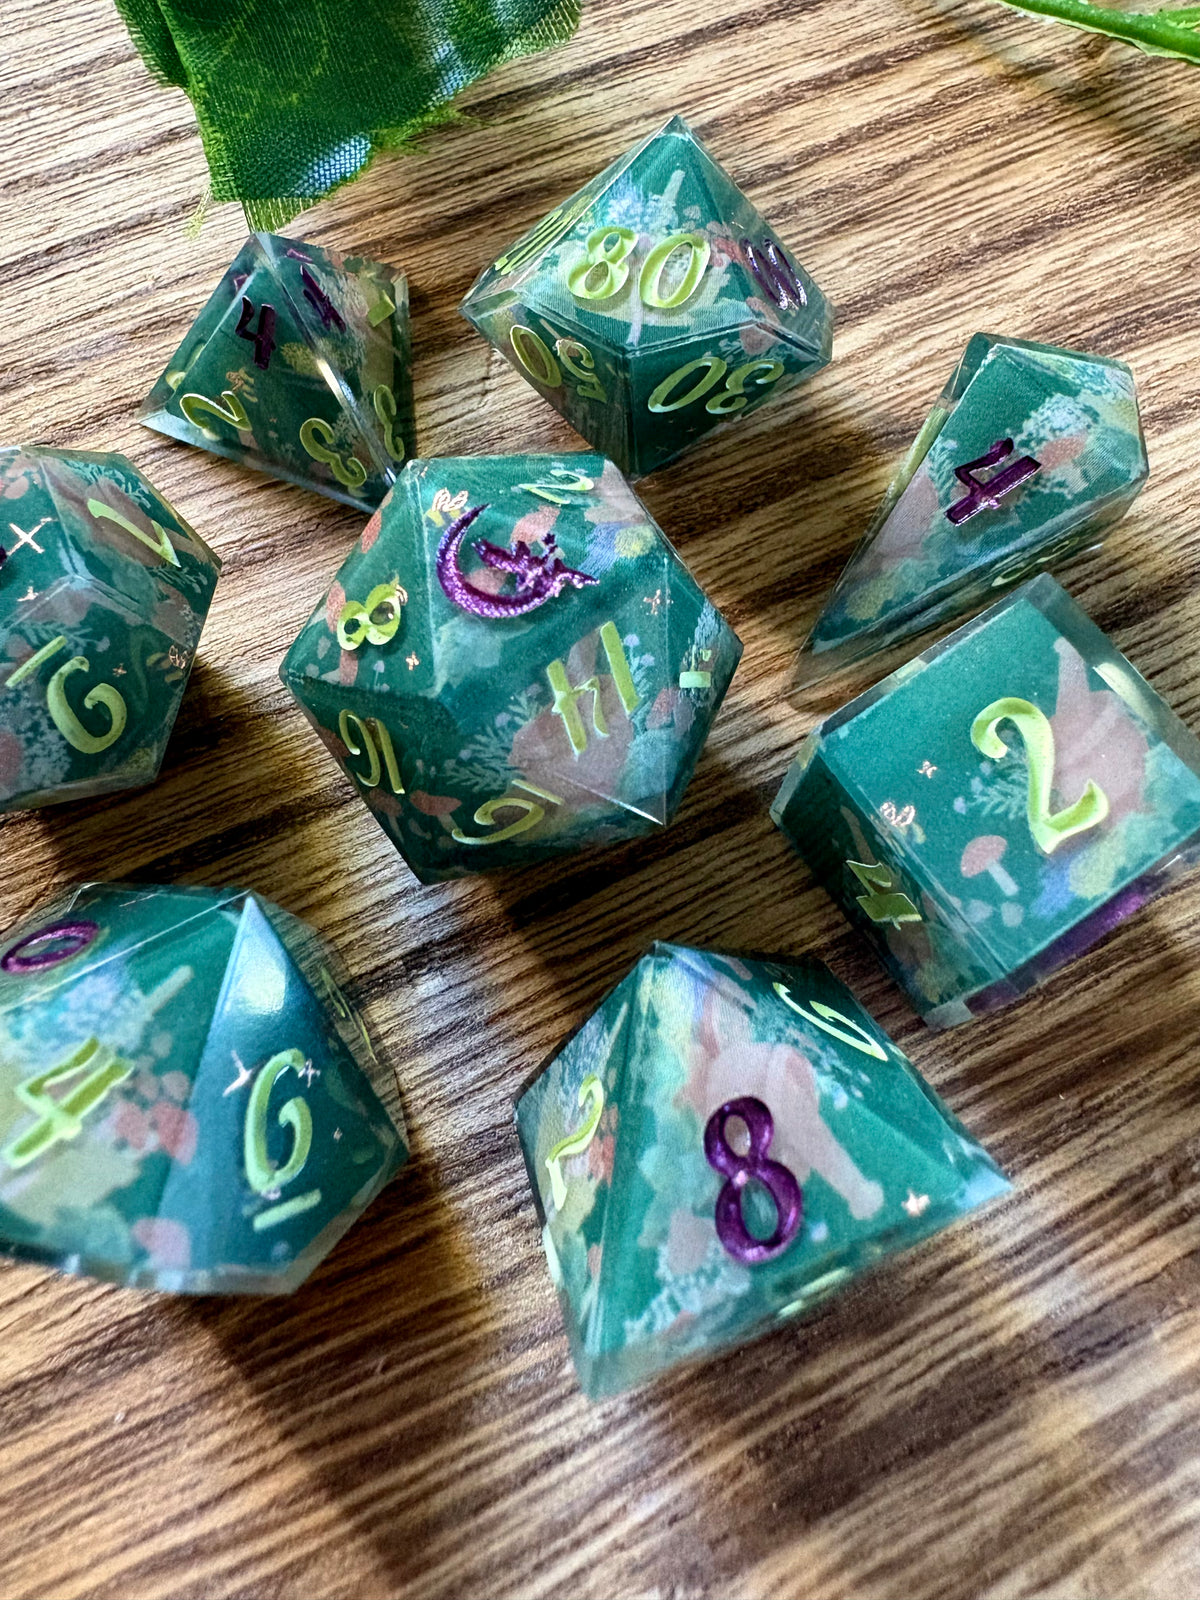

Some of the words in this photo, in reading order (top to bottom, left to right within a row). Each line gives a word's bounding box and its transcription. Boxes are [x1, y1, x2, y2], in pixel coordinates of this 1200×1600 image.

[567, 226, 711, 309] 80
[235, 295, 277, 370] 4
[299, 417, 367, 487] 3
[944, 437, 1043, 527] 4
[336, 581, 402, 652] 8
[970, 696, 1109, 855] 2
[1, 920, 100, 975] 0
[4, 1037, 136, 1170] 4
[703, 1095, 803, 1266] 8
